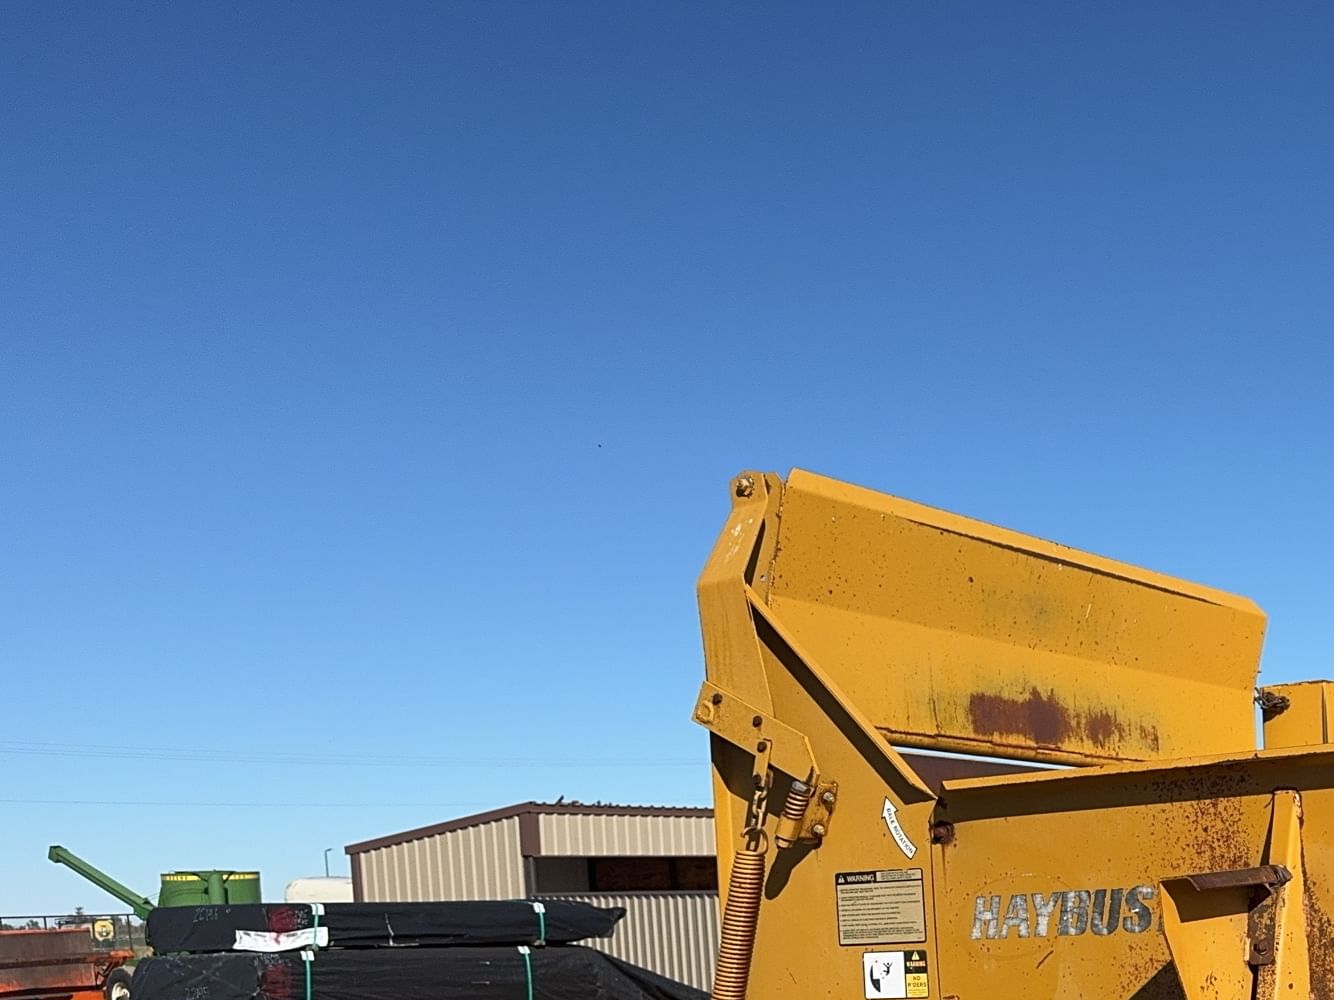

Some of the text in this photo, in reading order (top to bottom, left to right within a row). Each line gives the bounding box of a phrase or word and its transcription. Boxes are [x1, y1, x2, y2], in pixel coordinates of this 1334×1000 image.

[893, 826, 914, 854] ROTATION
[846, 874, 875, 882] WARNING
[970, 885, 1158, 940] HAYBUS
